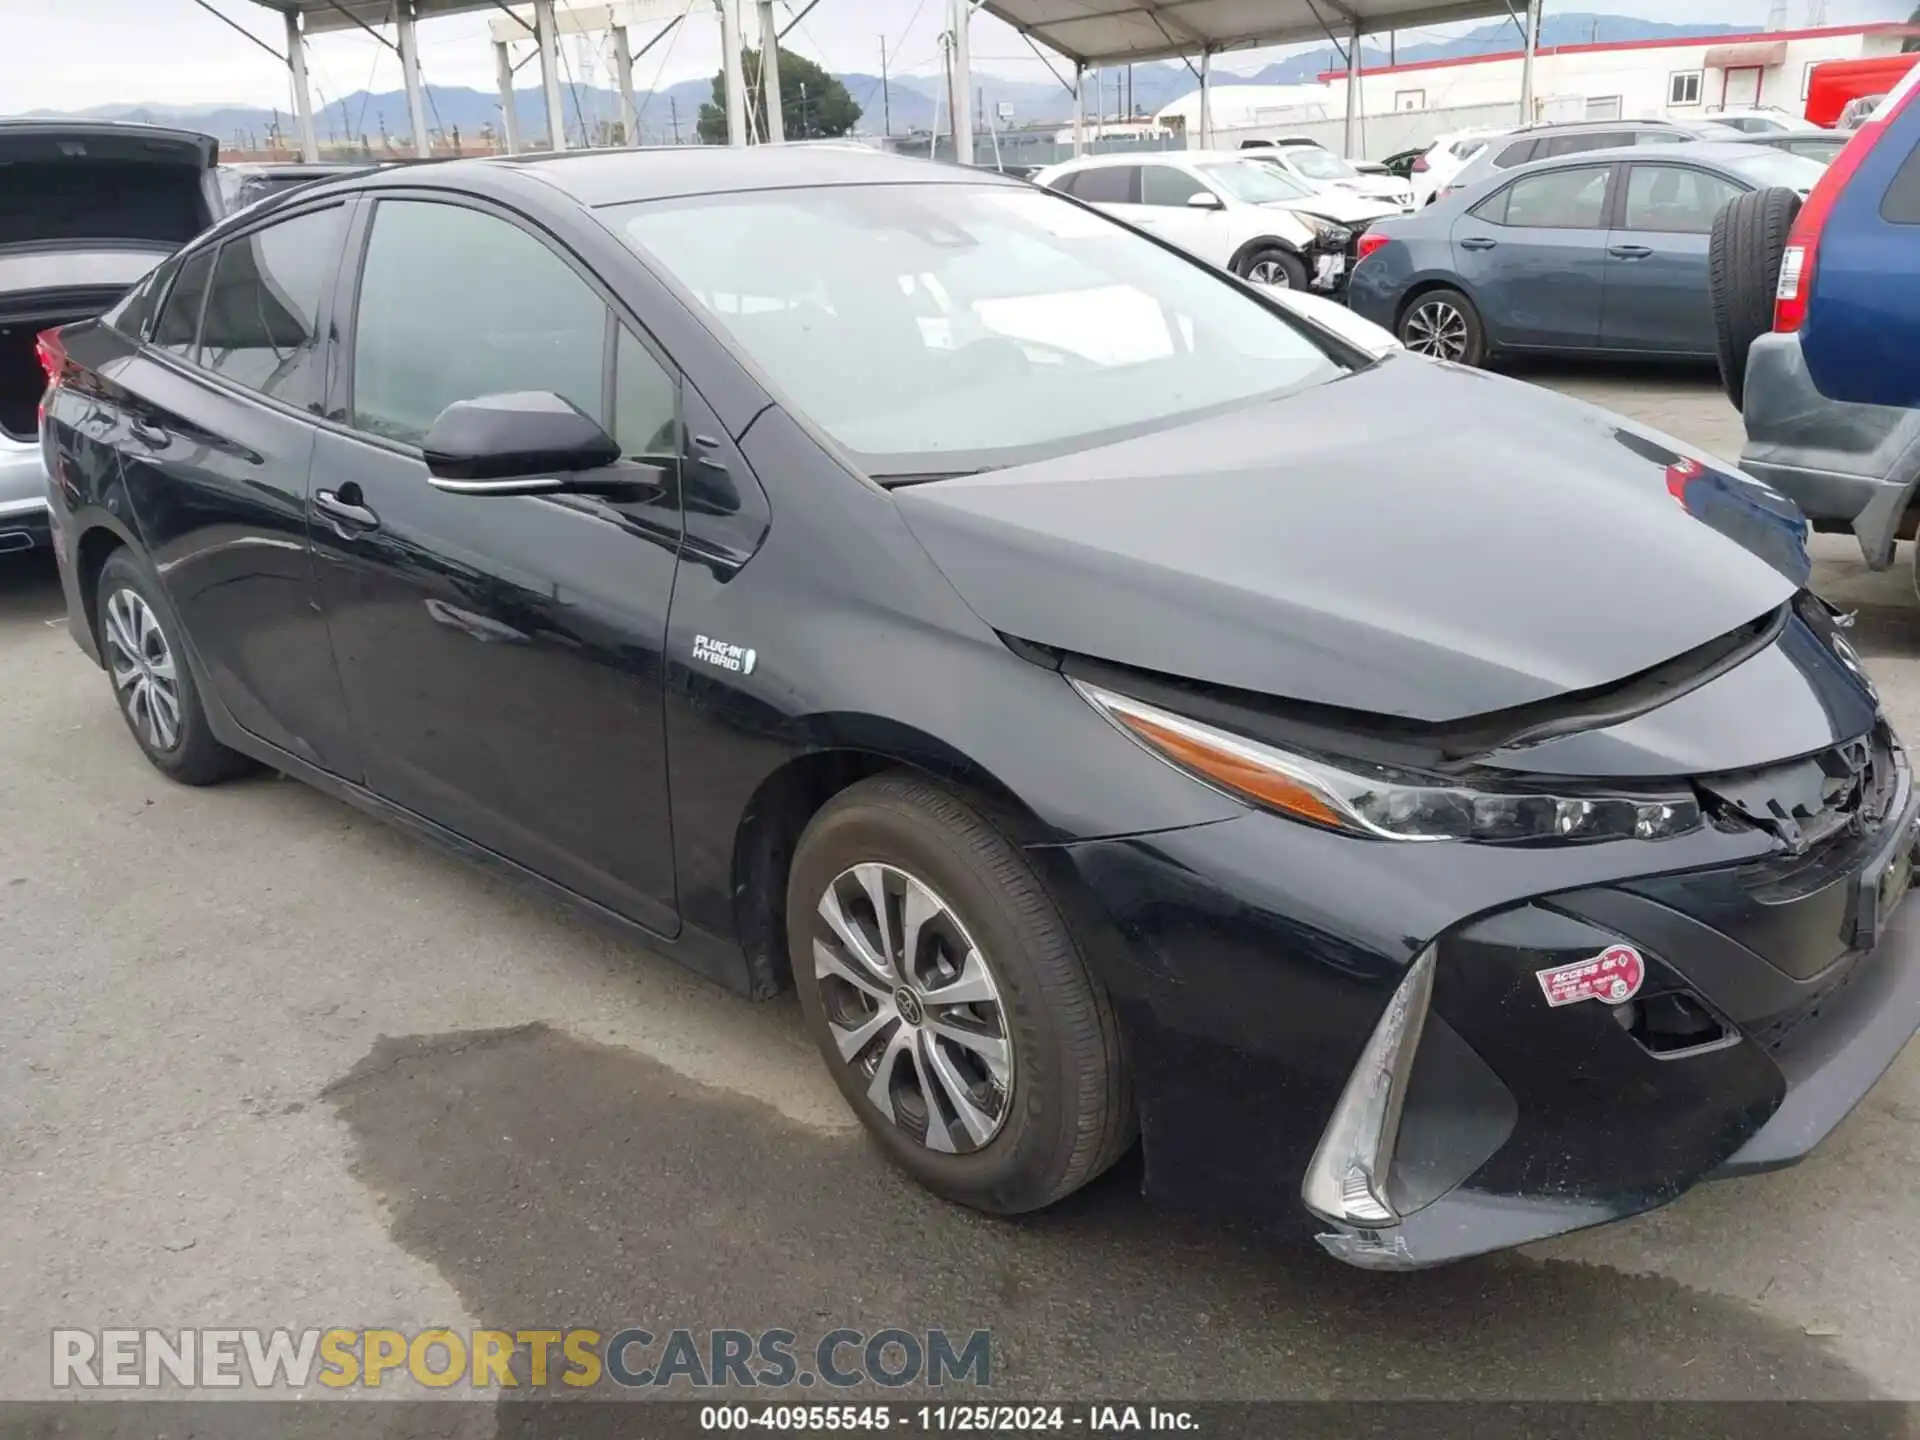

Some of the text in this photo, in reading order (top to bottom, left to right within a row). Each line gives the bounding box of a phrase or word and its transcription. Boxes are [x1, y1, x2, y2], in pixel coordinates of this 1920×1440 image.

[692, 646, 740, 670] HYBRID
[695, 634, 742, 659] PLUG-IN
[1552, 964, 1599, 983] ACCESS
